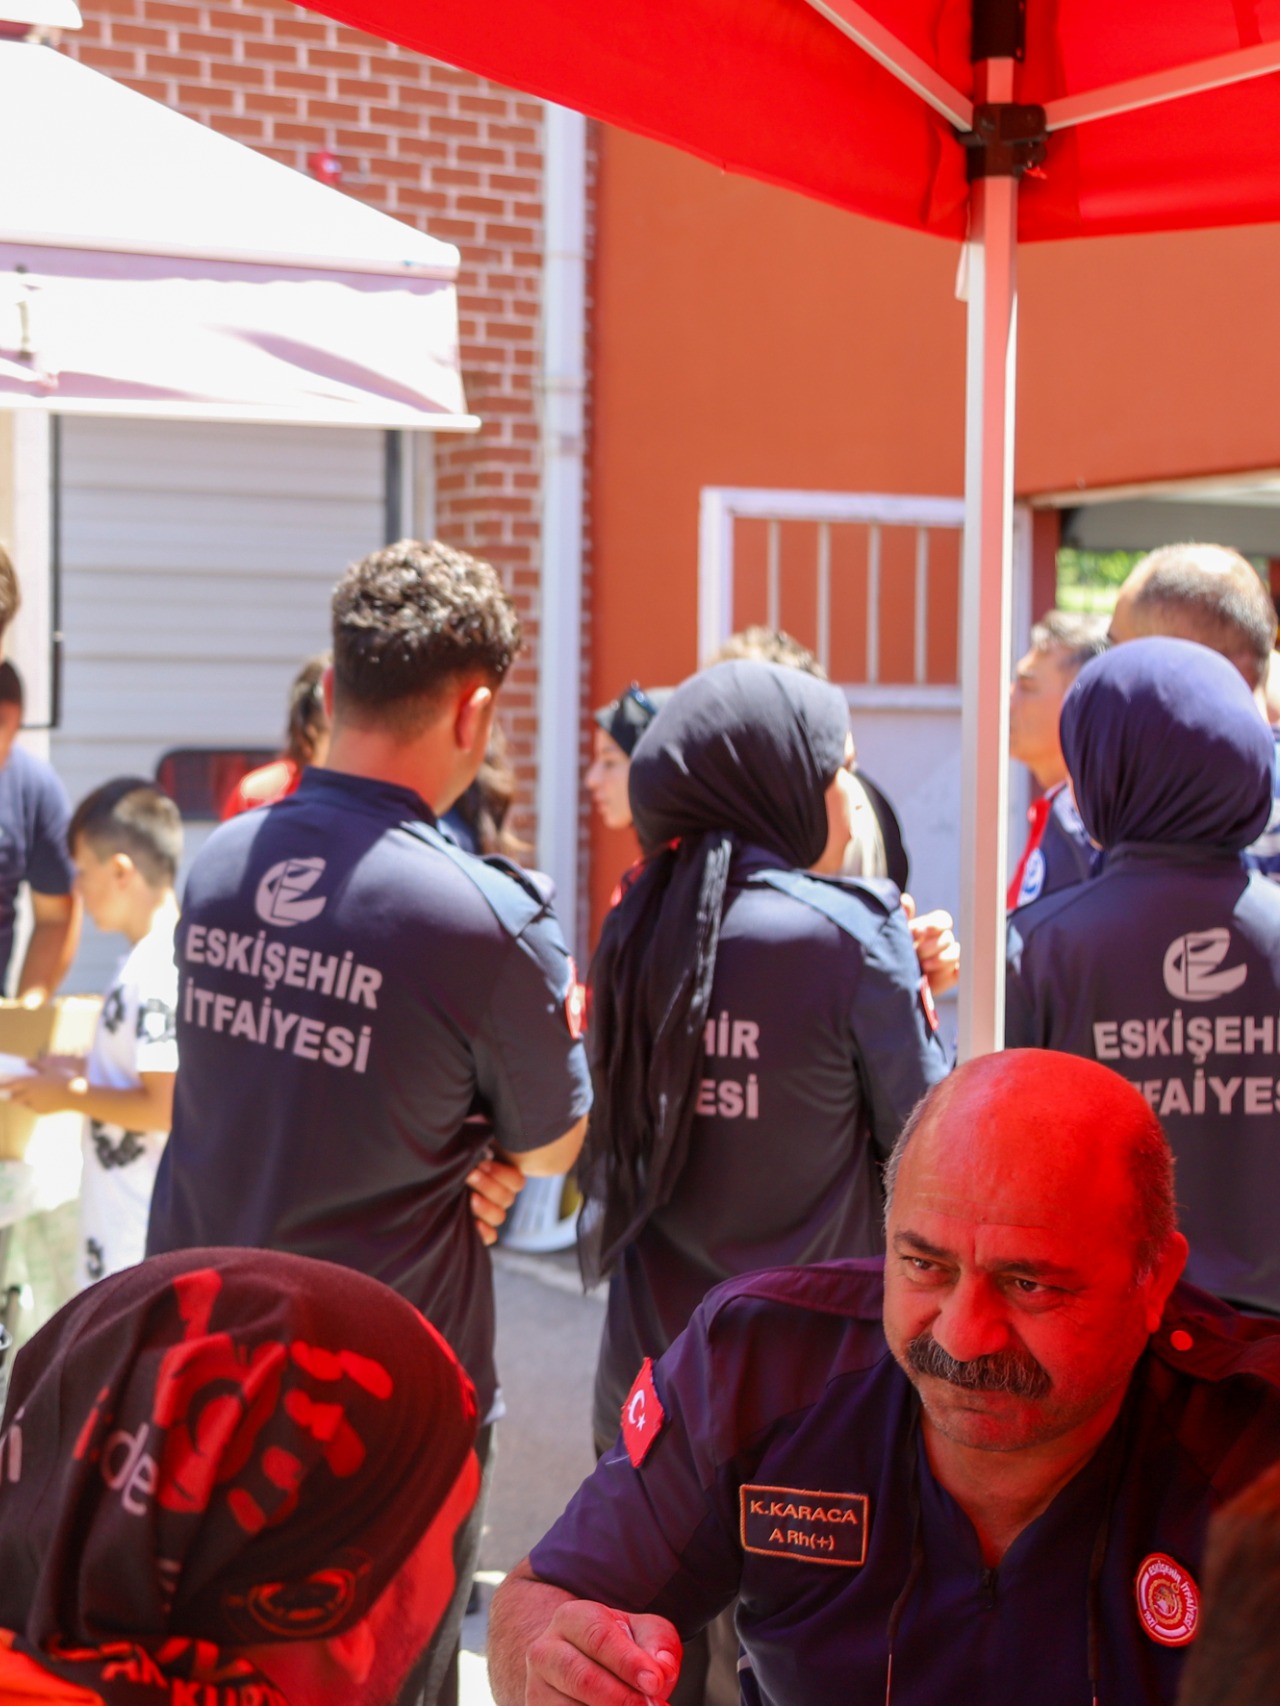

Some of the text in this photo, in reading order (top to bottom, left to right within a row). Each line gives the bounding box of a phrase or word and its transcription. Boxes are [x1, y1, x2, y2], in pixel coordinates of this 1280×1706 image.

[185, 924, 383, 1009] ESKİŞEHİR
[183, 977, 372, 1073] İTFAİYESİ
[1093, 1008, 1280, 1064] ESKİŞEH
[750, 1500, 858, 1524] K.KARACA
[768, 1528, 835, 1551] A Rh(+)
